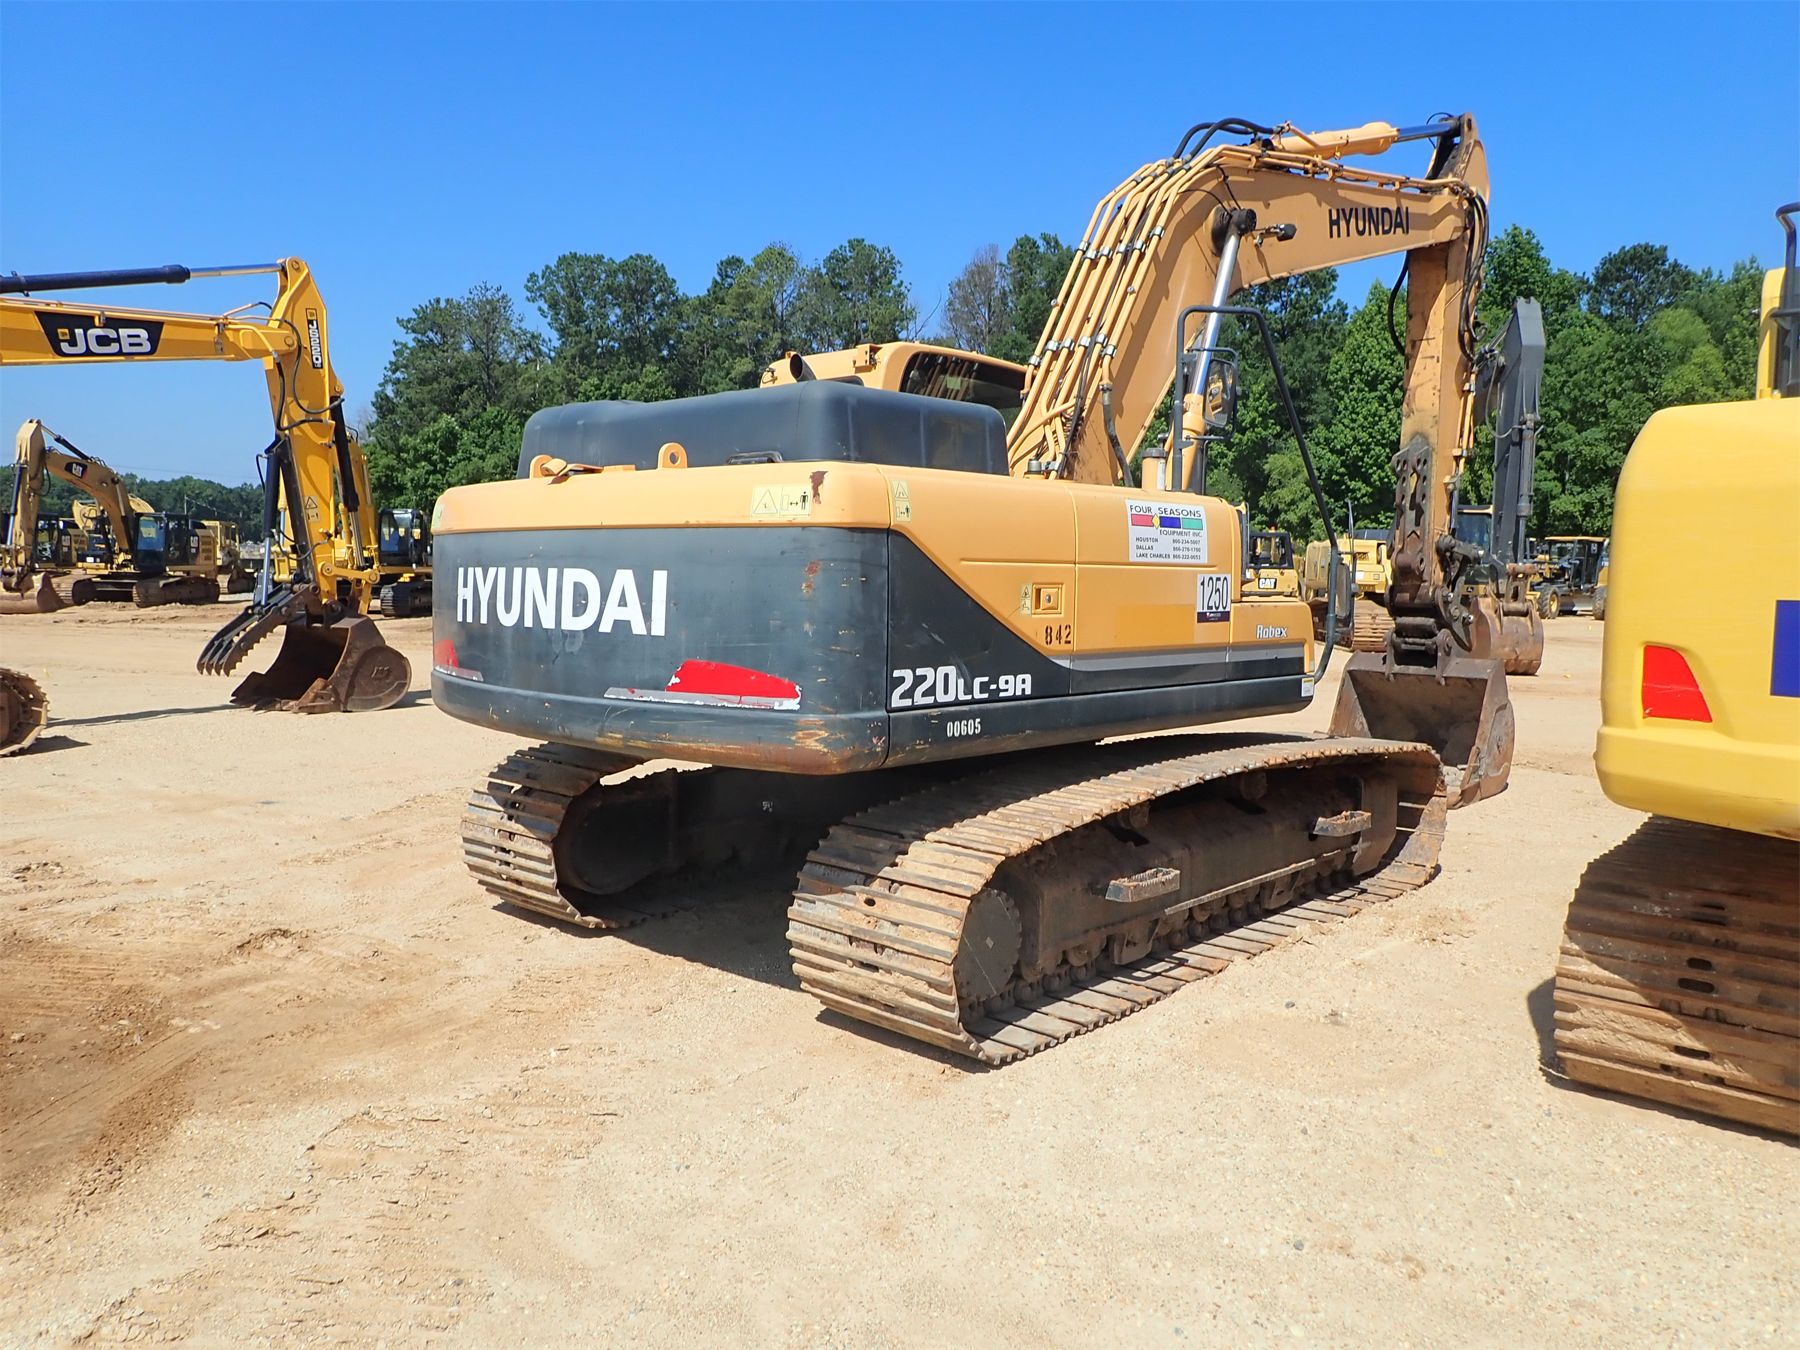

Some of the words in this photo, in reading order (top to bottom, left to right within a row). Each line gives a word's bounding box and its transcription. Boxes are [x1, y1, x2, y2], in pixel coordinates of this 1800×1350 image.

[1328, 206, 1409, 239] HYUNDAI
[60, 328, 151, 354] JCB
[72, 463, 83, 477] CAT
[1129, 505, 1153, 514] FOUR
[1158, 507, 1202, 518] SEASONS
[1200, 576, 1229, 611] 1250
[1259, 578, 1276, 589] CAT
[456, 566, 668, 636] HYUNDAI
[1044, 624, 1072, 645] 842
[1256, 625, 1287, 639] Robex
[891, 665, 1032, 708] 220LC-9A
[946, 718, 981, 738] 00605
